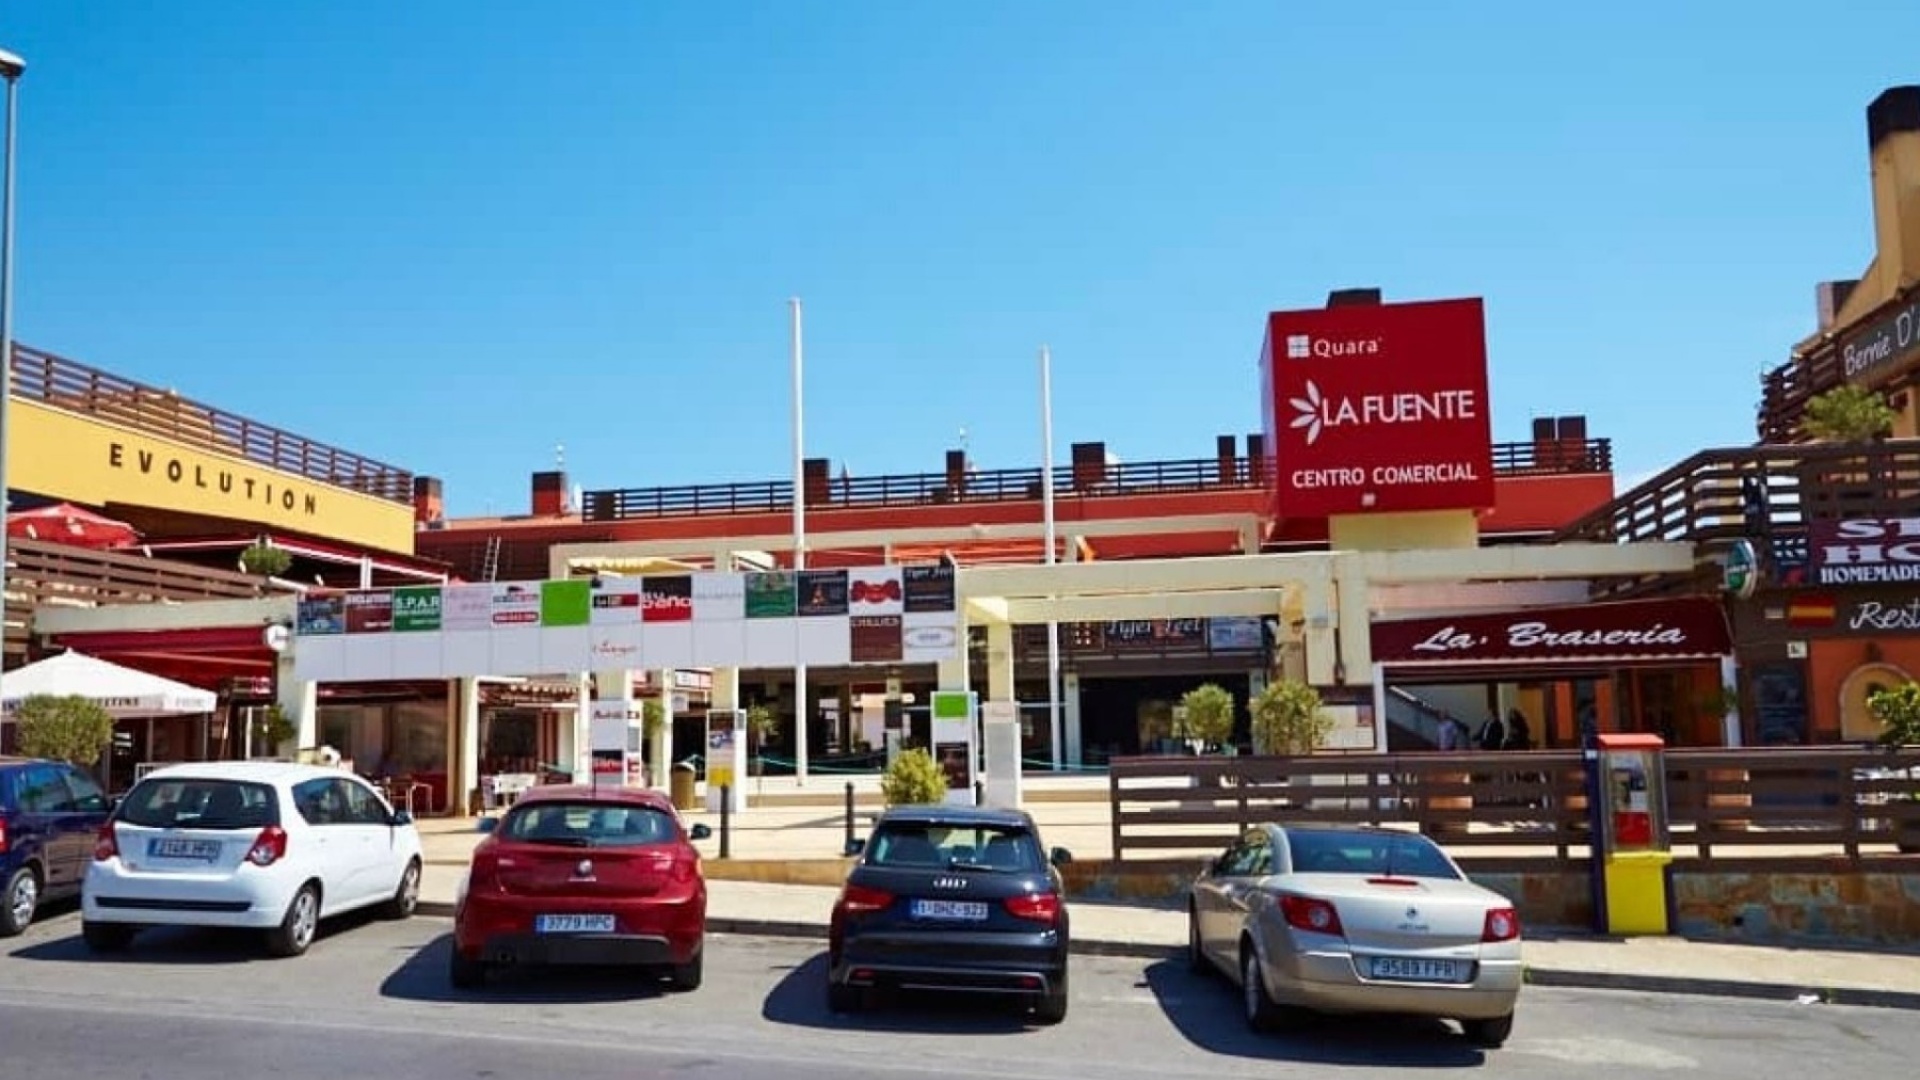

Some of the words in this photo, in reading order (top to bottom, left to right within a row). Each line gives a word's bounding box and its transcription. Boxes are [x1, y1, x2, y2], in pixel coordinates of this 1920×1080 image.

[1313, 337, 1382, 358] Quara
[1843, 330, 1892, 376] Bernie
[1322, 397, 1360, 426] LA
[1361, 390, 1476, 423] FUENTE
[109, 443, 316, 515] EVOLUTION
[1292, 467, 1366, 488] CENTRO
[1371, 463, 1479, 485] COMERCIAL
